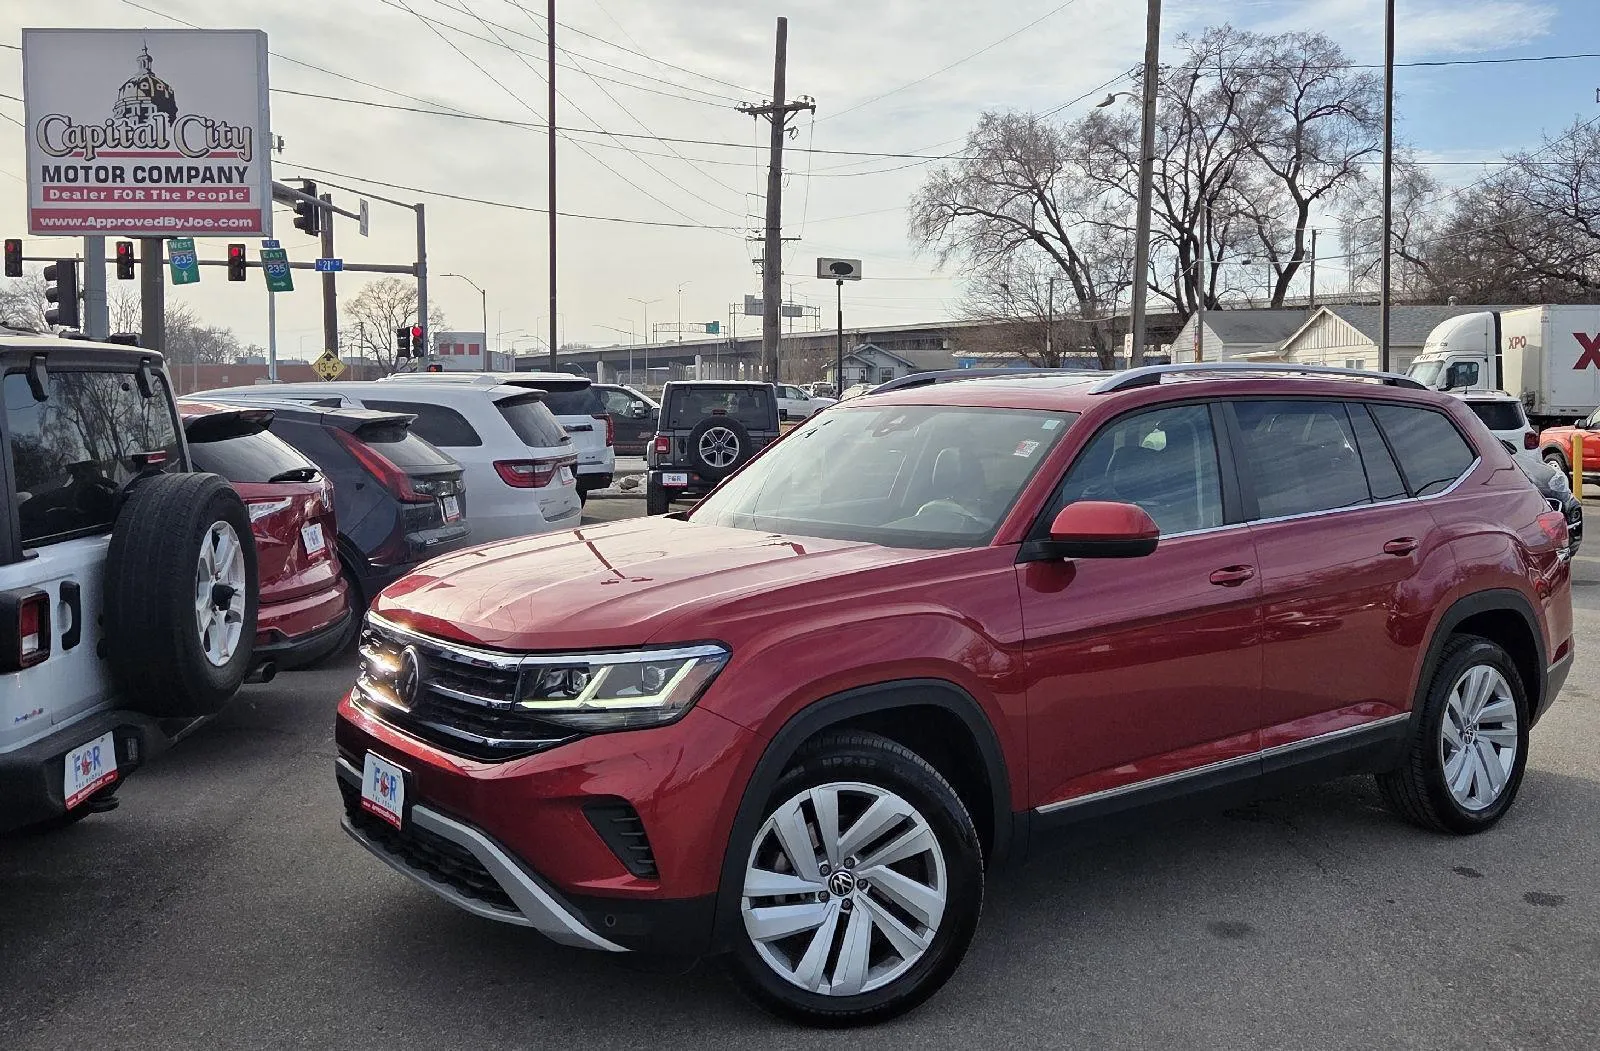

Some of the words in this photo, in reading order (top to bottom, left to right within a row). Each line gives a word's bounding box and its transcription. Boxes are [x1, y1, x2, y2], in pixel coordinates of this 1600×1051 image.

[36, 114, 170, 161] Capital
[174, 114, 252, 162] City
[42, 165, 125, 183] MOTOR
[133, 165, 248, 183] COMPANY
[49, 189, 107, 199] Dealer
[113, 189, 145, 200] FOR
[150, 190, 181, 200] The
[40, 216, 252, 228] www.ApprovedByJoe.com
[169, 241, 192, 249] WEST
[174, 254, 193, 265] 235
[263, 251, 283, 259] EAST
[267, 264, 286, 274] 235
[1508, 336, 1526, 349] XPO
[74, 745, 101, 782] FOR
[373, 767, 397, 803] FOR
